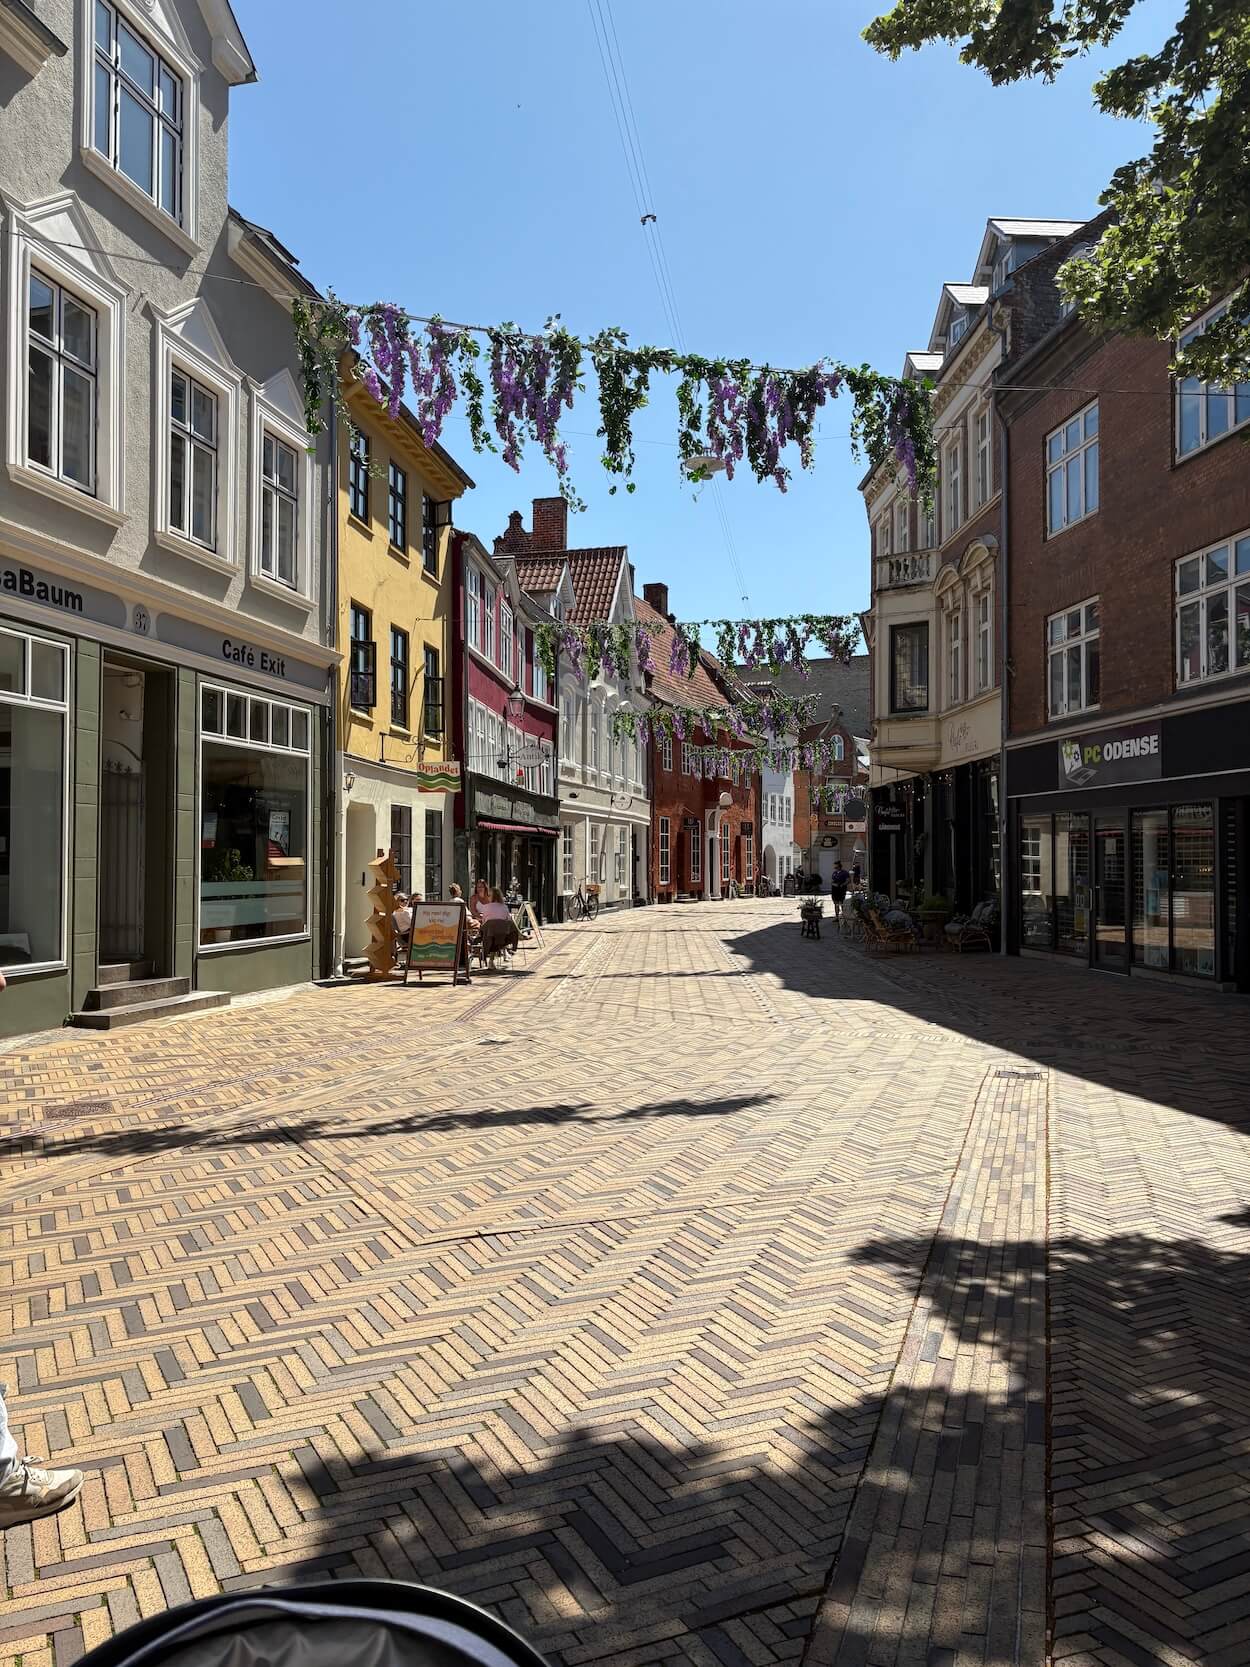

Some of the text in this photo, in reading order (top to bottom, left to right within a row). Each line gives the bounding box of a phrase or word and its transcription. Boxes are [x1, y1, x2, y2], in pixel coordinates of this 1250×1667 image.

[135, 611, 147, 631] 37
[222, 639, 285, 677] Café Exit
[1083, 734, 1159, 765] PC ODENSE
